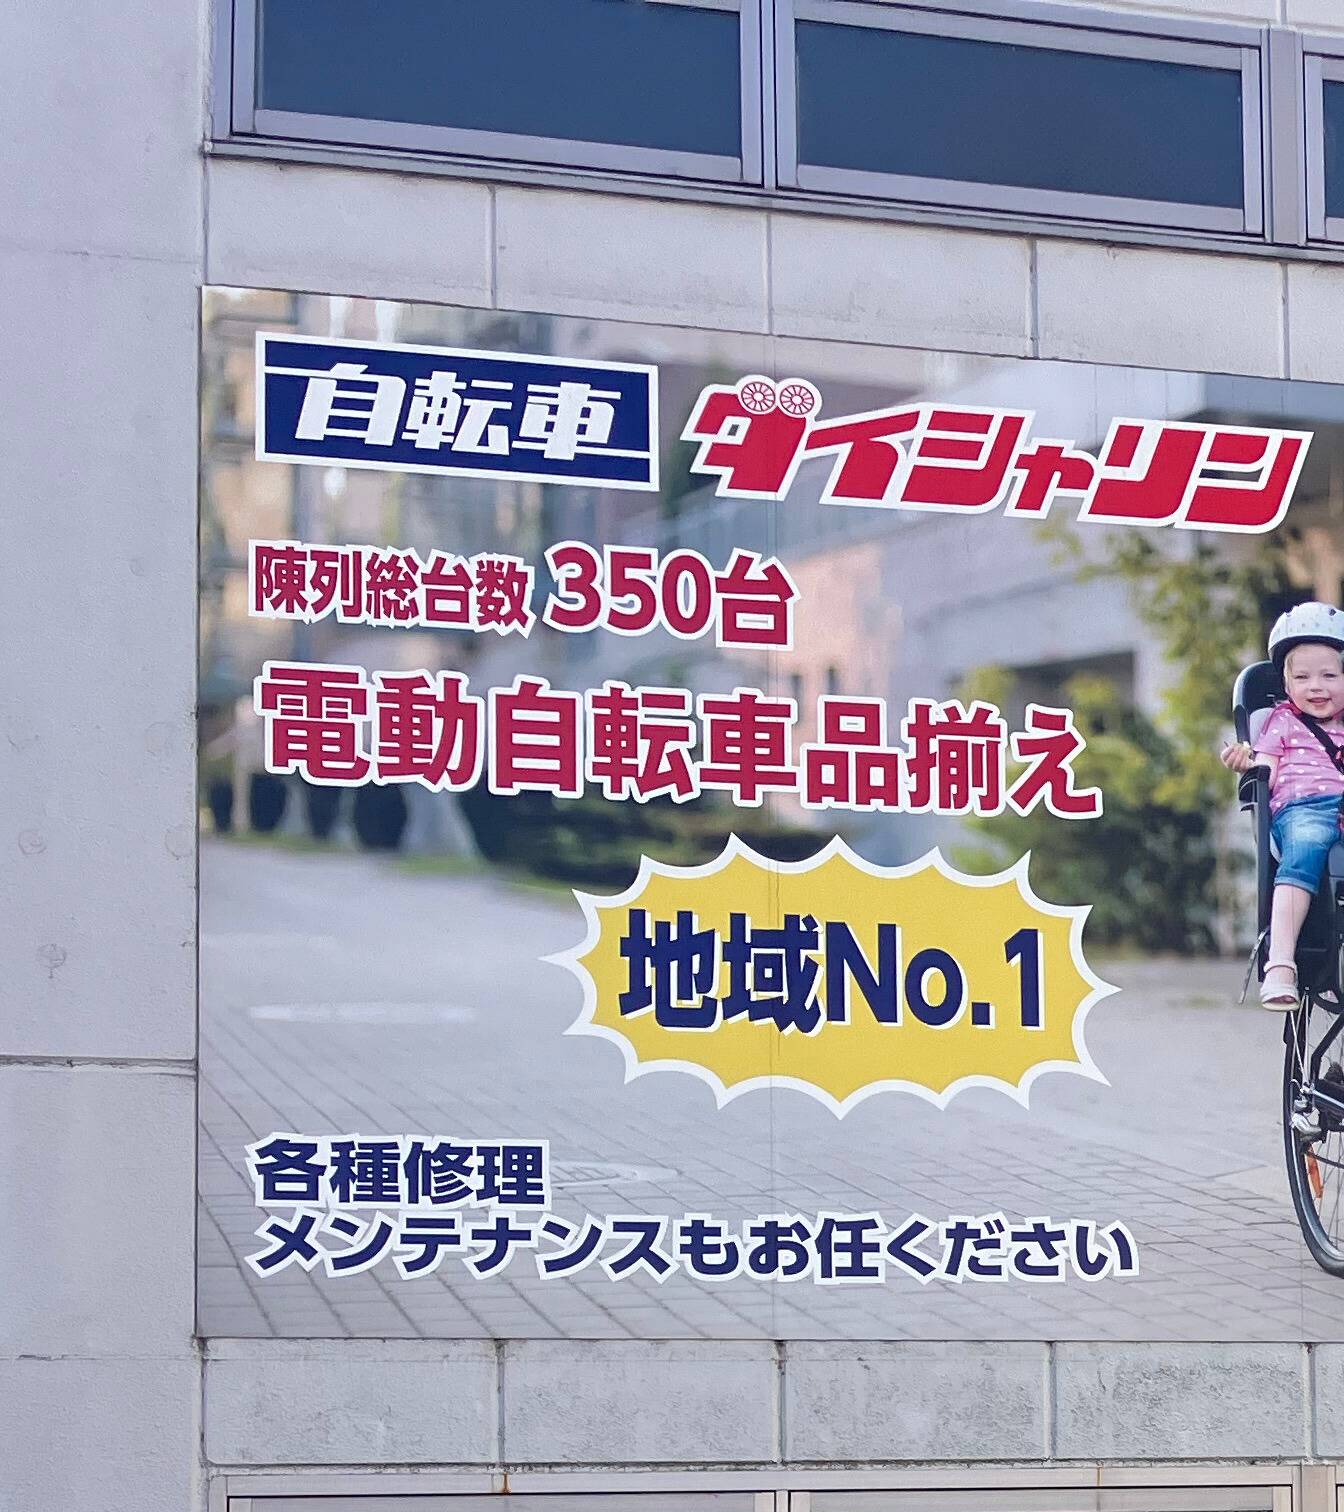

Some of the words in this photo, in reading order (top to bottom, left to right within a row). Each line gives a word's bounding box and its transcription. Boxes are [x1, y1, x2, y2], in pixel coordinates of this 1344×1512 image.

[296, 362, 622, 462] 自転車
[684, 376, 1308, 533] ダイシャリン
[258, 662, 1102, 818] 電動自転車品揃え
[619, 908, 1048, 1034] 地域No.1
[253, 1136, 548, 1206] 各種修理
[252, 1216, 1138, 1282] メンテナンスもお任ください
